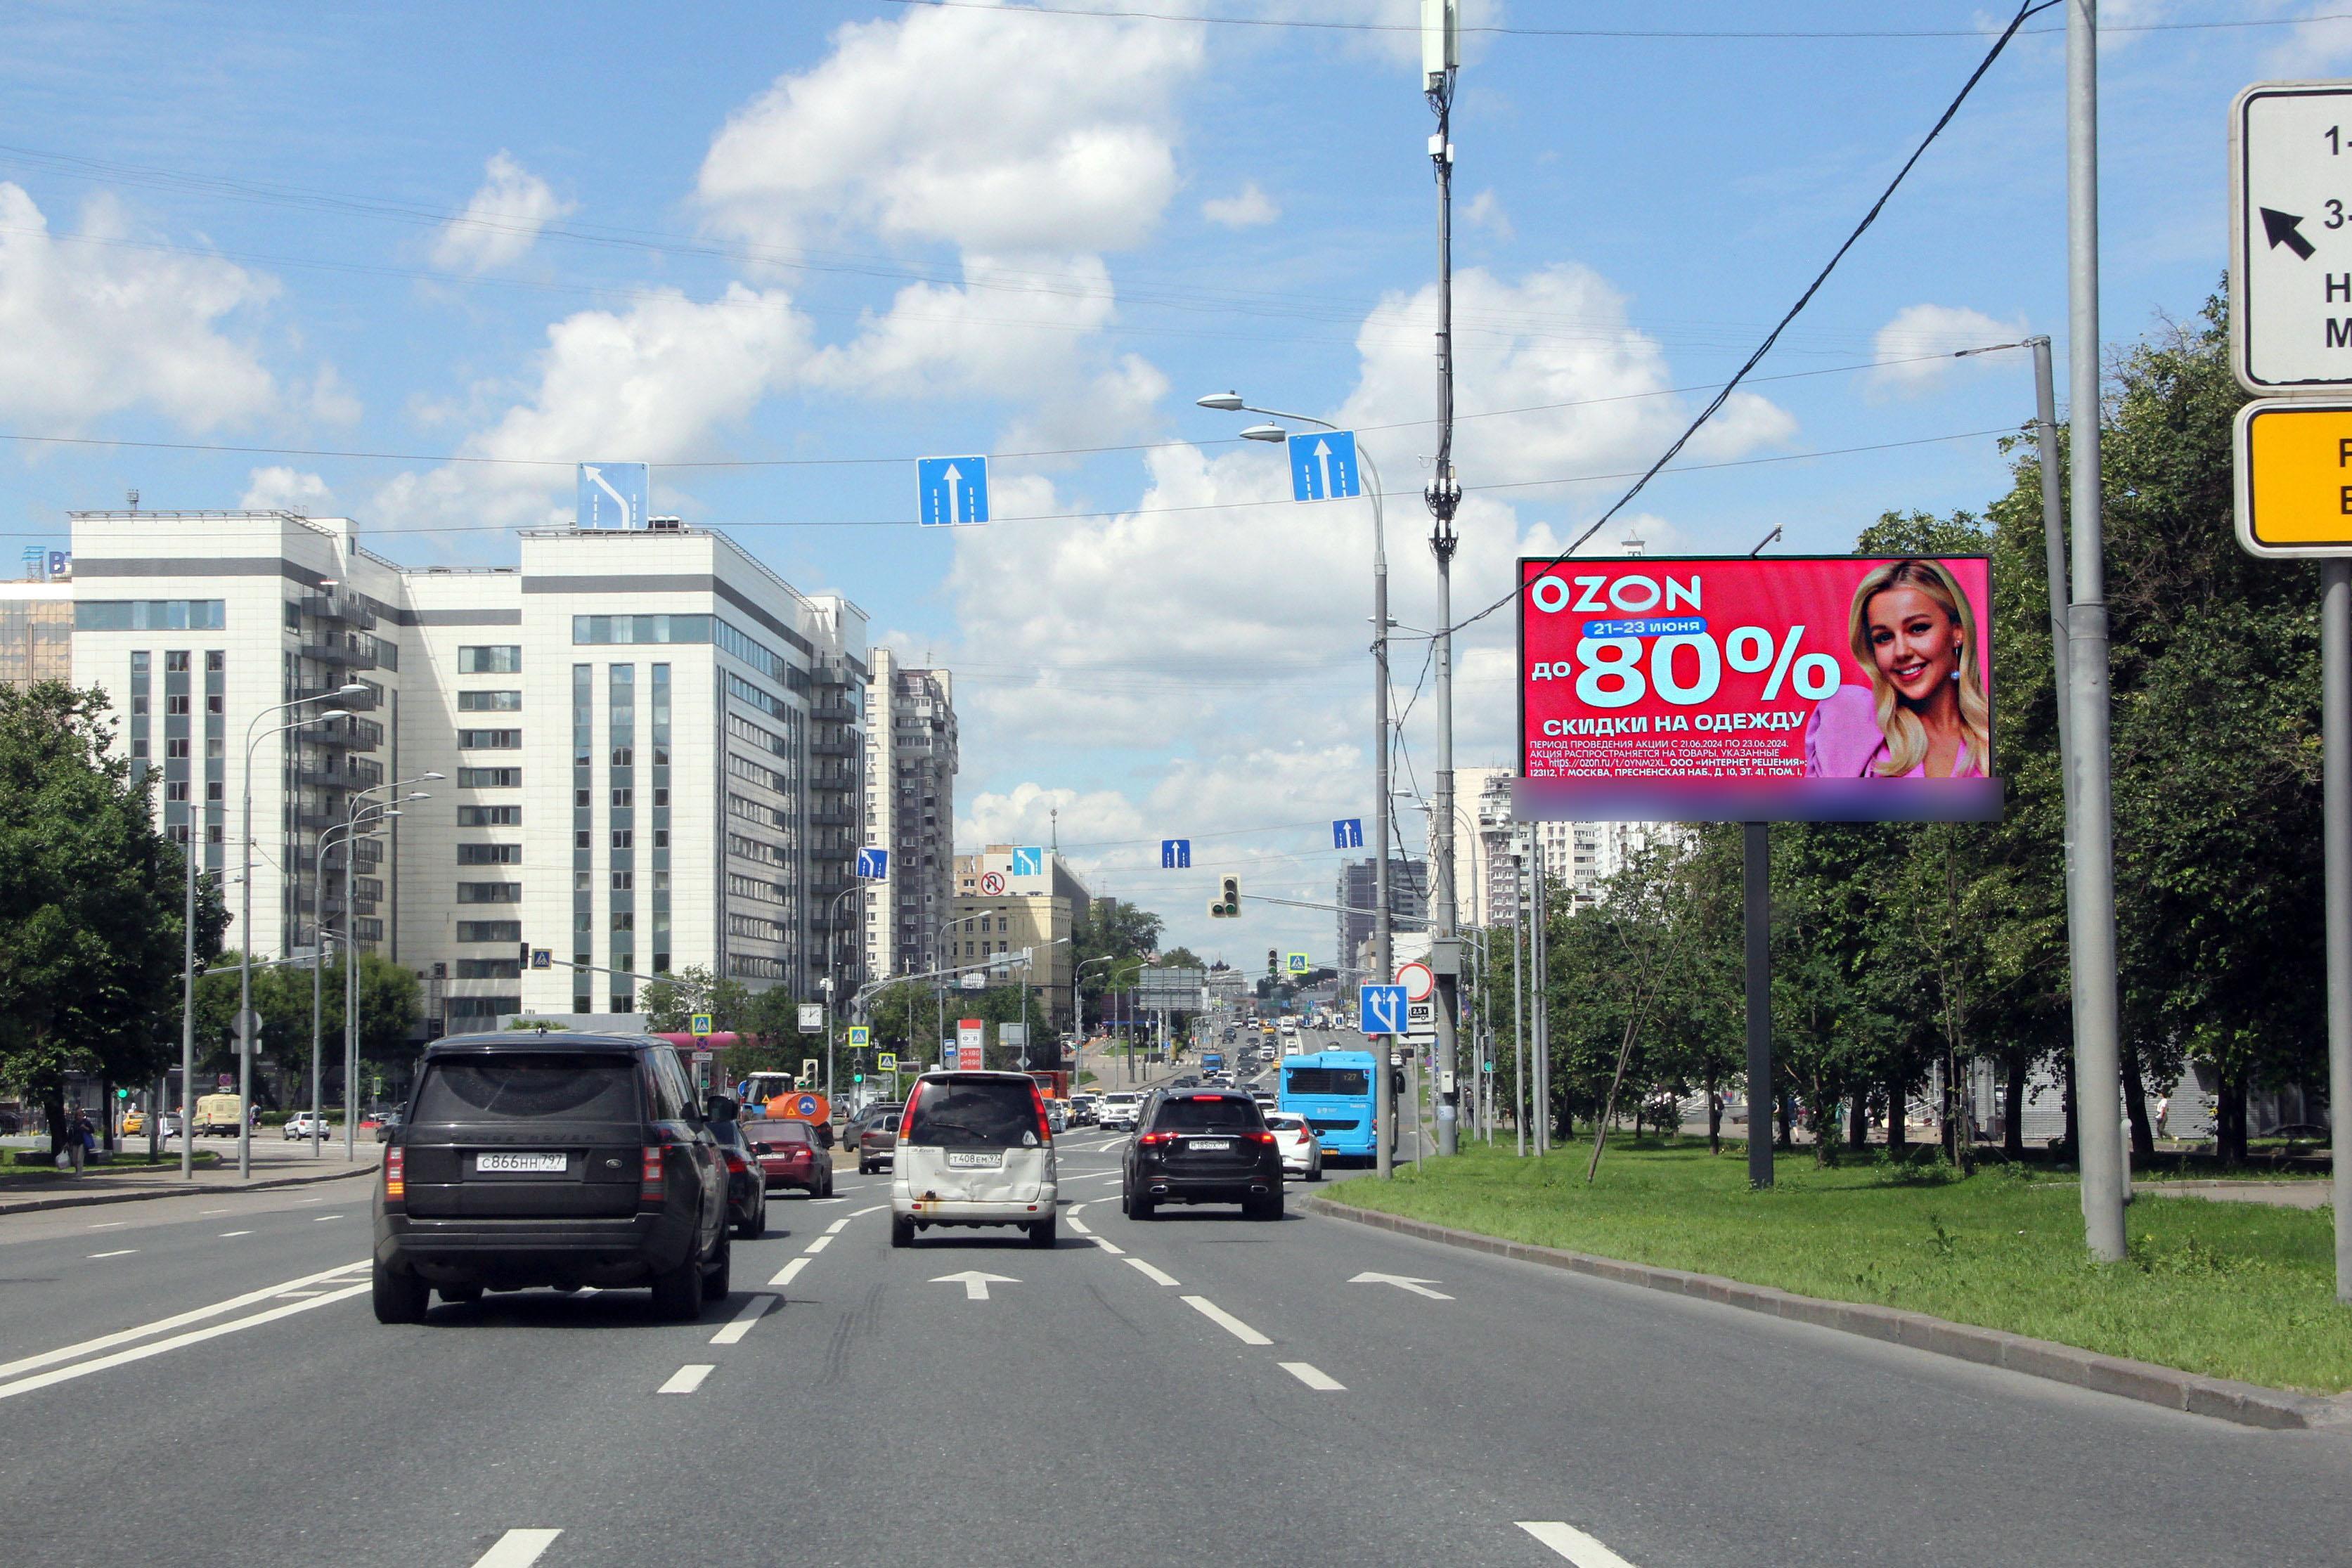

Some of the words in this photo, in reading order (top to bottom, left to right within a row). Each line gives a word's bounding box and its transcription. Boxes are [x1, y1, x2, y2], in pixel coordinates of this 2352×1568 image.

[1532, 575, 1701, 613] OZON
[1532, 661, 1572, 681] до
[1575, 625, 1841, 708] 80%
[1543, 715, 1648, 737] СКИДКИ
[1655, 715, 1689, 732] НА
[1694, 711, 1806, 733] ОДЕЖДУ
[1530, 740, 1568, 750] ПЕРИОД
[1570, 740, 1633, 749] ПРОВЕДЕНИЯ
[1635, 740, 1669, 749] АКЦИИ
[1530, 750, 1562, 759] АКЦИЯ
[1564, 749, 1660, 758] РАСПРОСТРАНЯЕТСЯ
[1678, 749, 1719, 758] ТОВАРЫ,
[1721, 749, 1780, 757] УКАЗАННЫЕ
[1669, 758, 1693, 767] ООО
[1695, 758, 1749, 767] «ИНТЕРНЕТ
[1568, 768, 1613, 777] МОСКВА,
[1615, 768, 1685, 777] ПРЕСНЕНСКАЯ
[1688, 768, 1712, 777] НАБ.,
[1714, 768, 1724, 777] Д.
